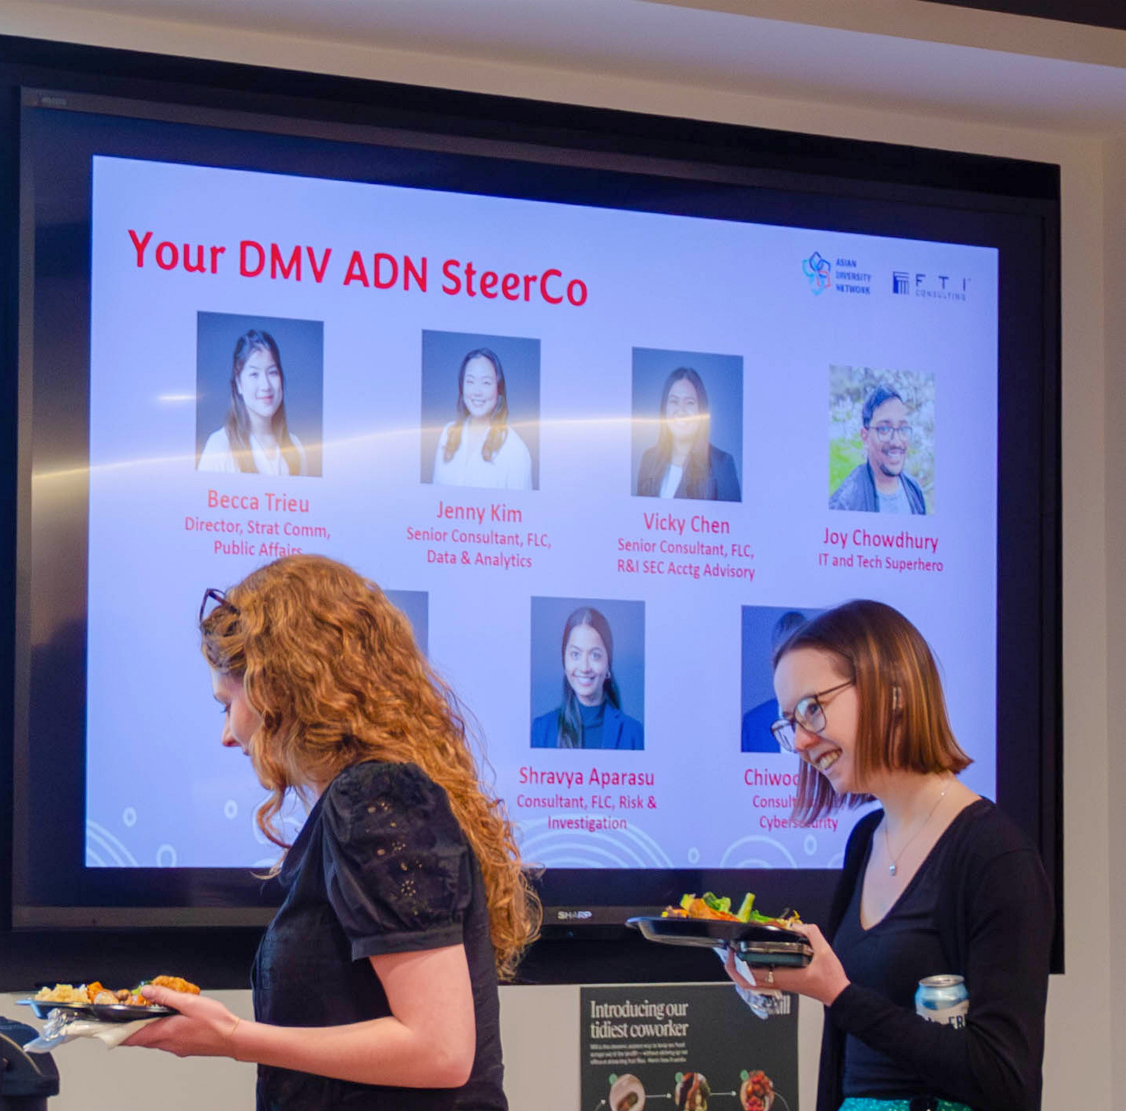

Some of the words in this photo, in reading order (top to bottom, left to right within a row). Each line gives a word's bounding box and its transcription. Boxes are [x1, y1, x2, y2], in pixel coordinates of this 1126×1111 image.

[128, 229, 226, 274] Your
[240, 240, 332, 283] DMV
[343, 250, 427, 293] ADN
[442, 259, 587, 306] SteerCo
[835, 258, 857, 268] ASIAN
[835, 270, 872, 282] DIVERSITY
[835, 283, 871, 295] NETWORK
[207, 489, 259, 510] Becca
[265, 493, 309, 512] Trieu
[436, 501, 485, 525] Jenny
[491, 504, 522, 522] Kim
[185, 516, 243, 535] Director,
[247, 520, 279, 535] Strat
[283, 522, 331, 540] Comm,
[643, 513, 686, 535] Vicky
[690, 515, 730, 534] Chen
[406, 526, 448, 542] Senior
[451, 529, 523, 548] Consultant,
[527, 532, 551, 549] FLC,
[823, 527, 848, 549] Joy
[852, 529, 939, 553] Chowdhury
[214, 540, 255, 556] Public
[259, 542, 302, 557] Affairs
[618, 538, 656, 552] Senior
[660, 540, 728, 558] Consultant,
[731, 544, 755, 559] FLC,
[427, 549, 457, 564] Data
[460, 550, 471, 565] &
[474, 552, 532, 570] Analytics
[818, 553, 829, 566] IT
[832, 554, 854, 568] and
[857, 554, 882, 569] Tech
[885, 556, 944, 572] Superhero
[618, 559, 639, 573] R&I
[643, 560, 665, 574] SEC
[667, 562, 700, 579] Acctg
[703, 563, 755, 582] Advisory
[519, 766, 583, 789] Shravya
[588, 767, 654, 789] Aparasu
[517, 794, 588, 810] Consultant,
[591, 795, 616, 811] FLC,
[619, 795, 644, 809] Risk
[647, 795, 657, 809] &
[548, 816, 627, 832] Investigation
[558, 910, 592, 920] SHARP
[590, 1000, 664, 1020] Introducing
[666, 1003, 689, 1017] our
[590, 1021, 628, 1039] tidiest
[630, 1019, 689, 1038] coworker
